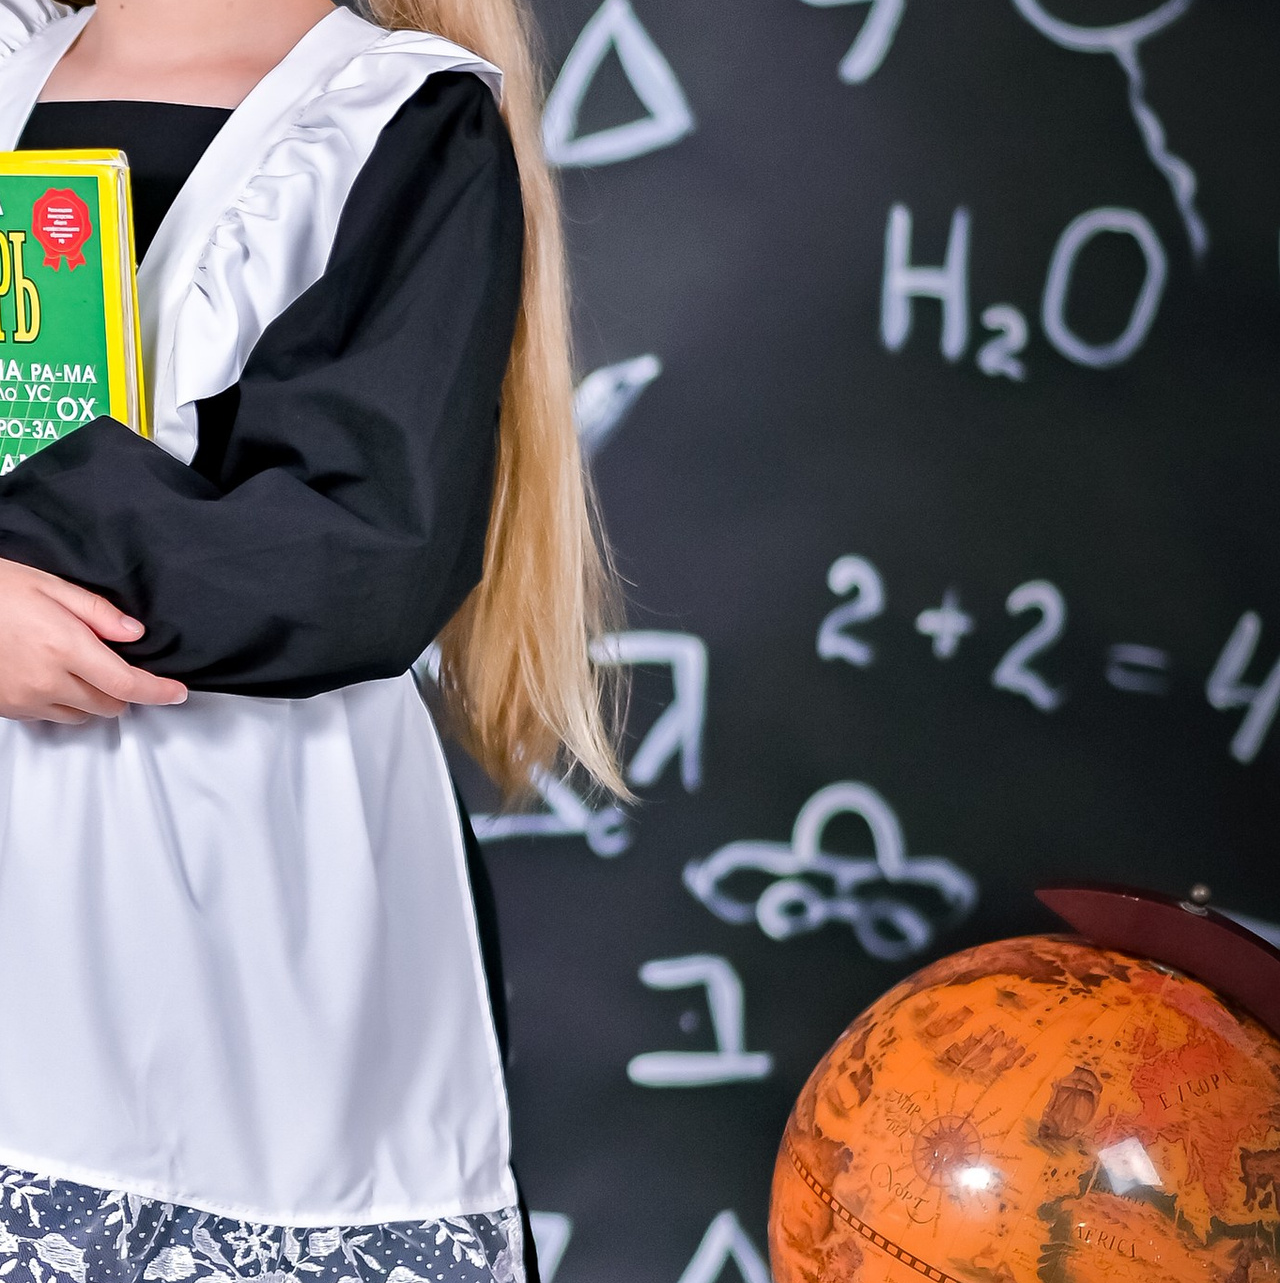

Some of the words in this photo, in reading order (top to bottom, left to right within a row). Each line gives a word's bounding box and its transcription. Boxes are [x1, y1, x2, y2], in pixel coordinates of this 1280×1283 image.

[30, 363, 97, 384] РА-МА
[24, 384, 51, 403] УС
[56, 397, 96, 422] ОХ
[0, 453, 28, 476] А
